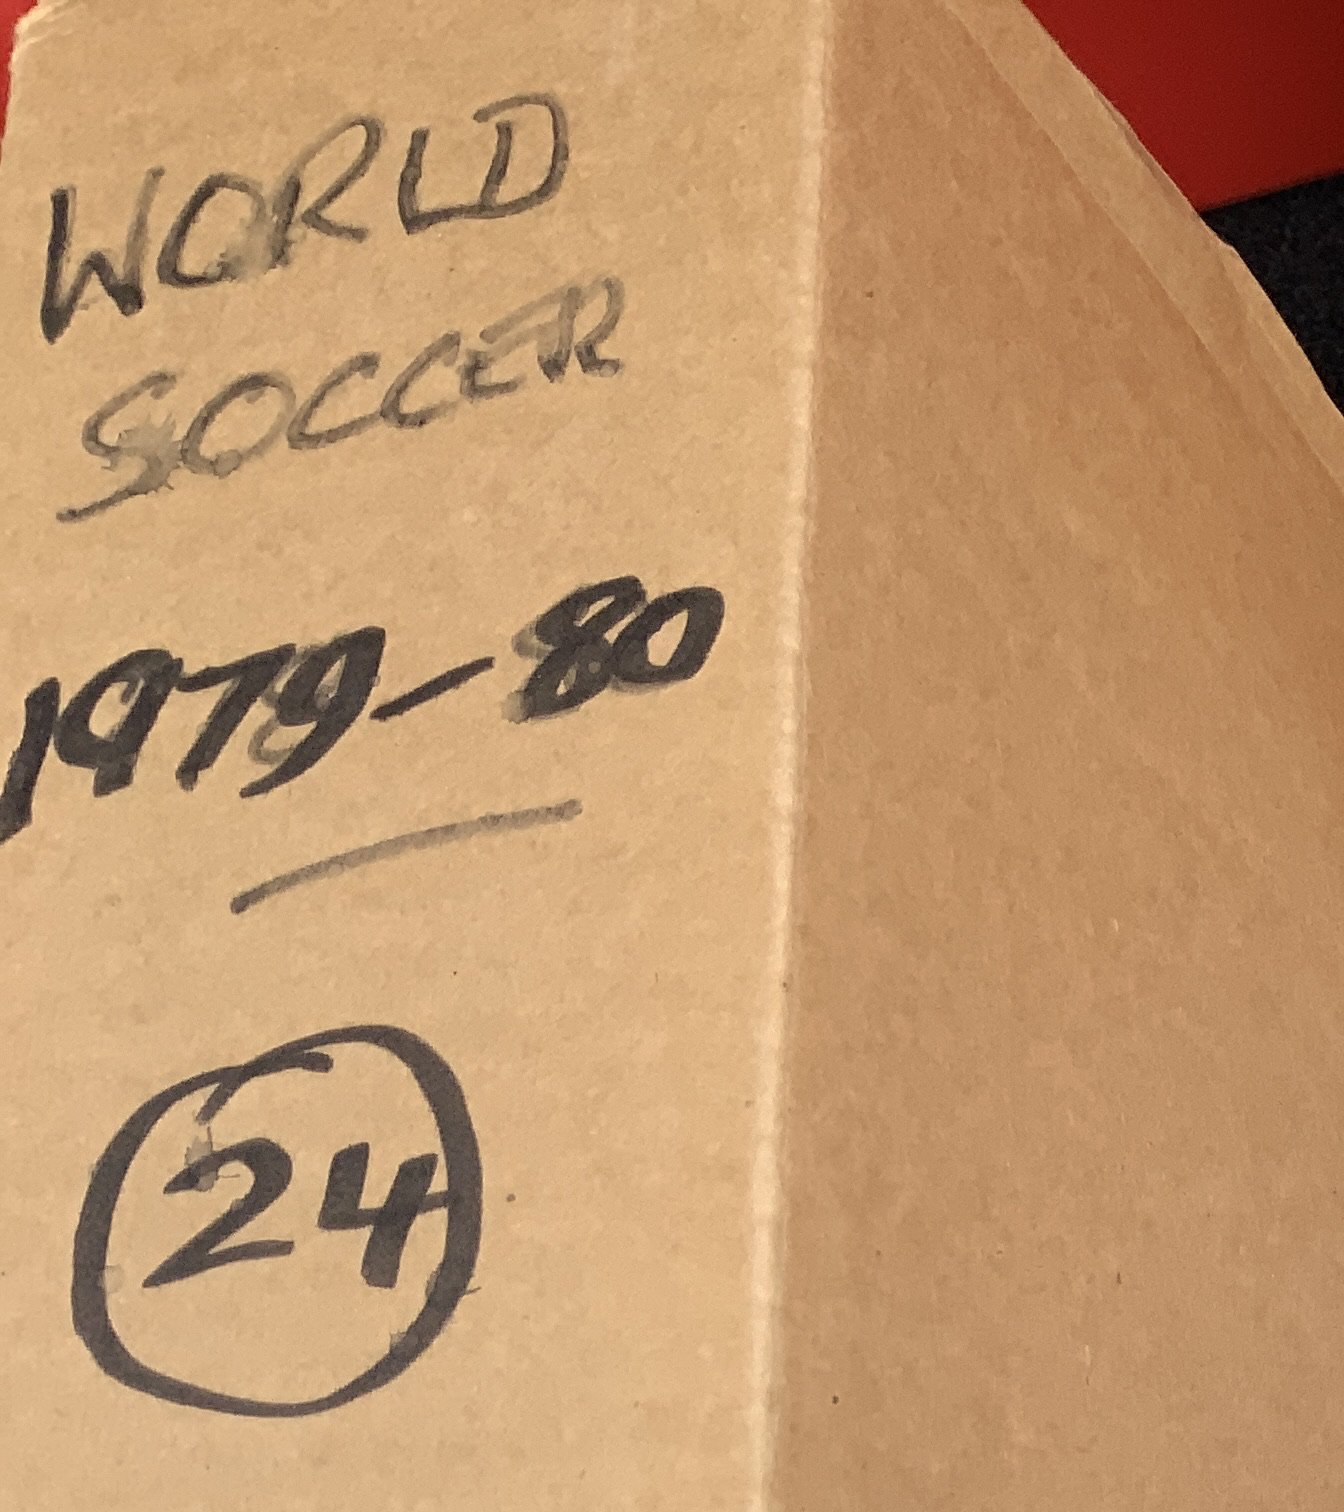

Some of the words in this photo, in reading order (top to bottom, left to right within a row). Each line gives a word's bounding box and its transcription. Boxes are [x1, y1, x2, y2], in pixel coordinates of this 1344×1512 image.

[40, 93, 568, 343] WORLD
[56, 276, 624, 522] SOCCER
[0, 576, 725, 842] 1979-80
[143, 1137, 449, 1289] 24
